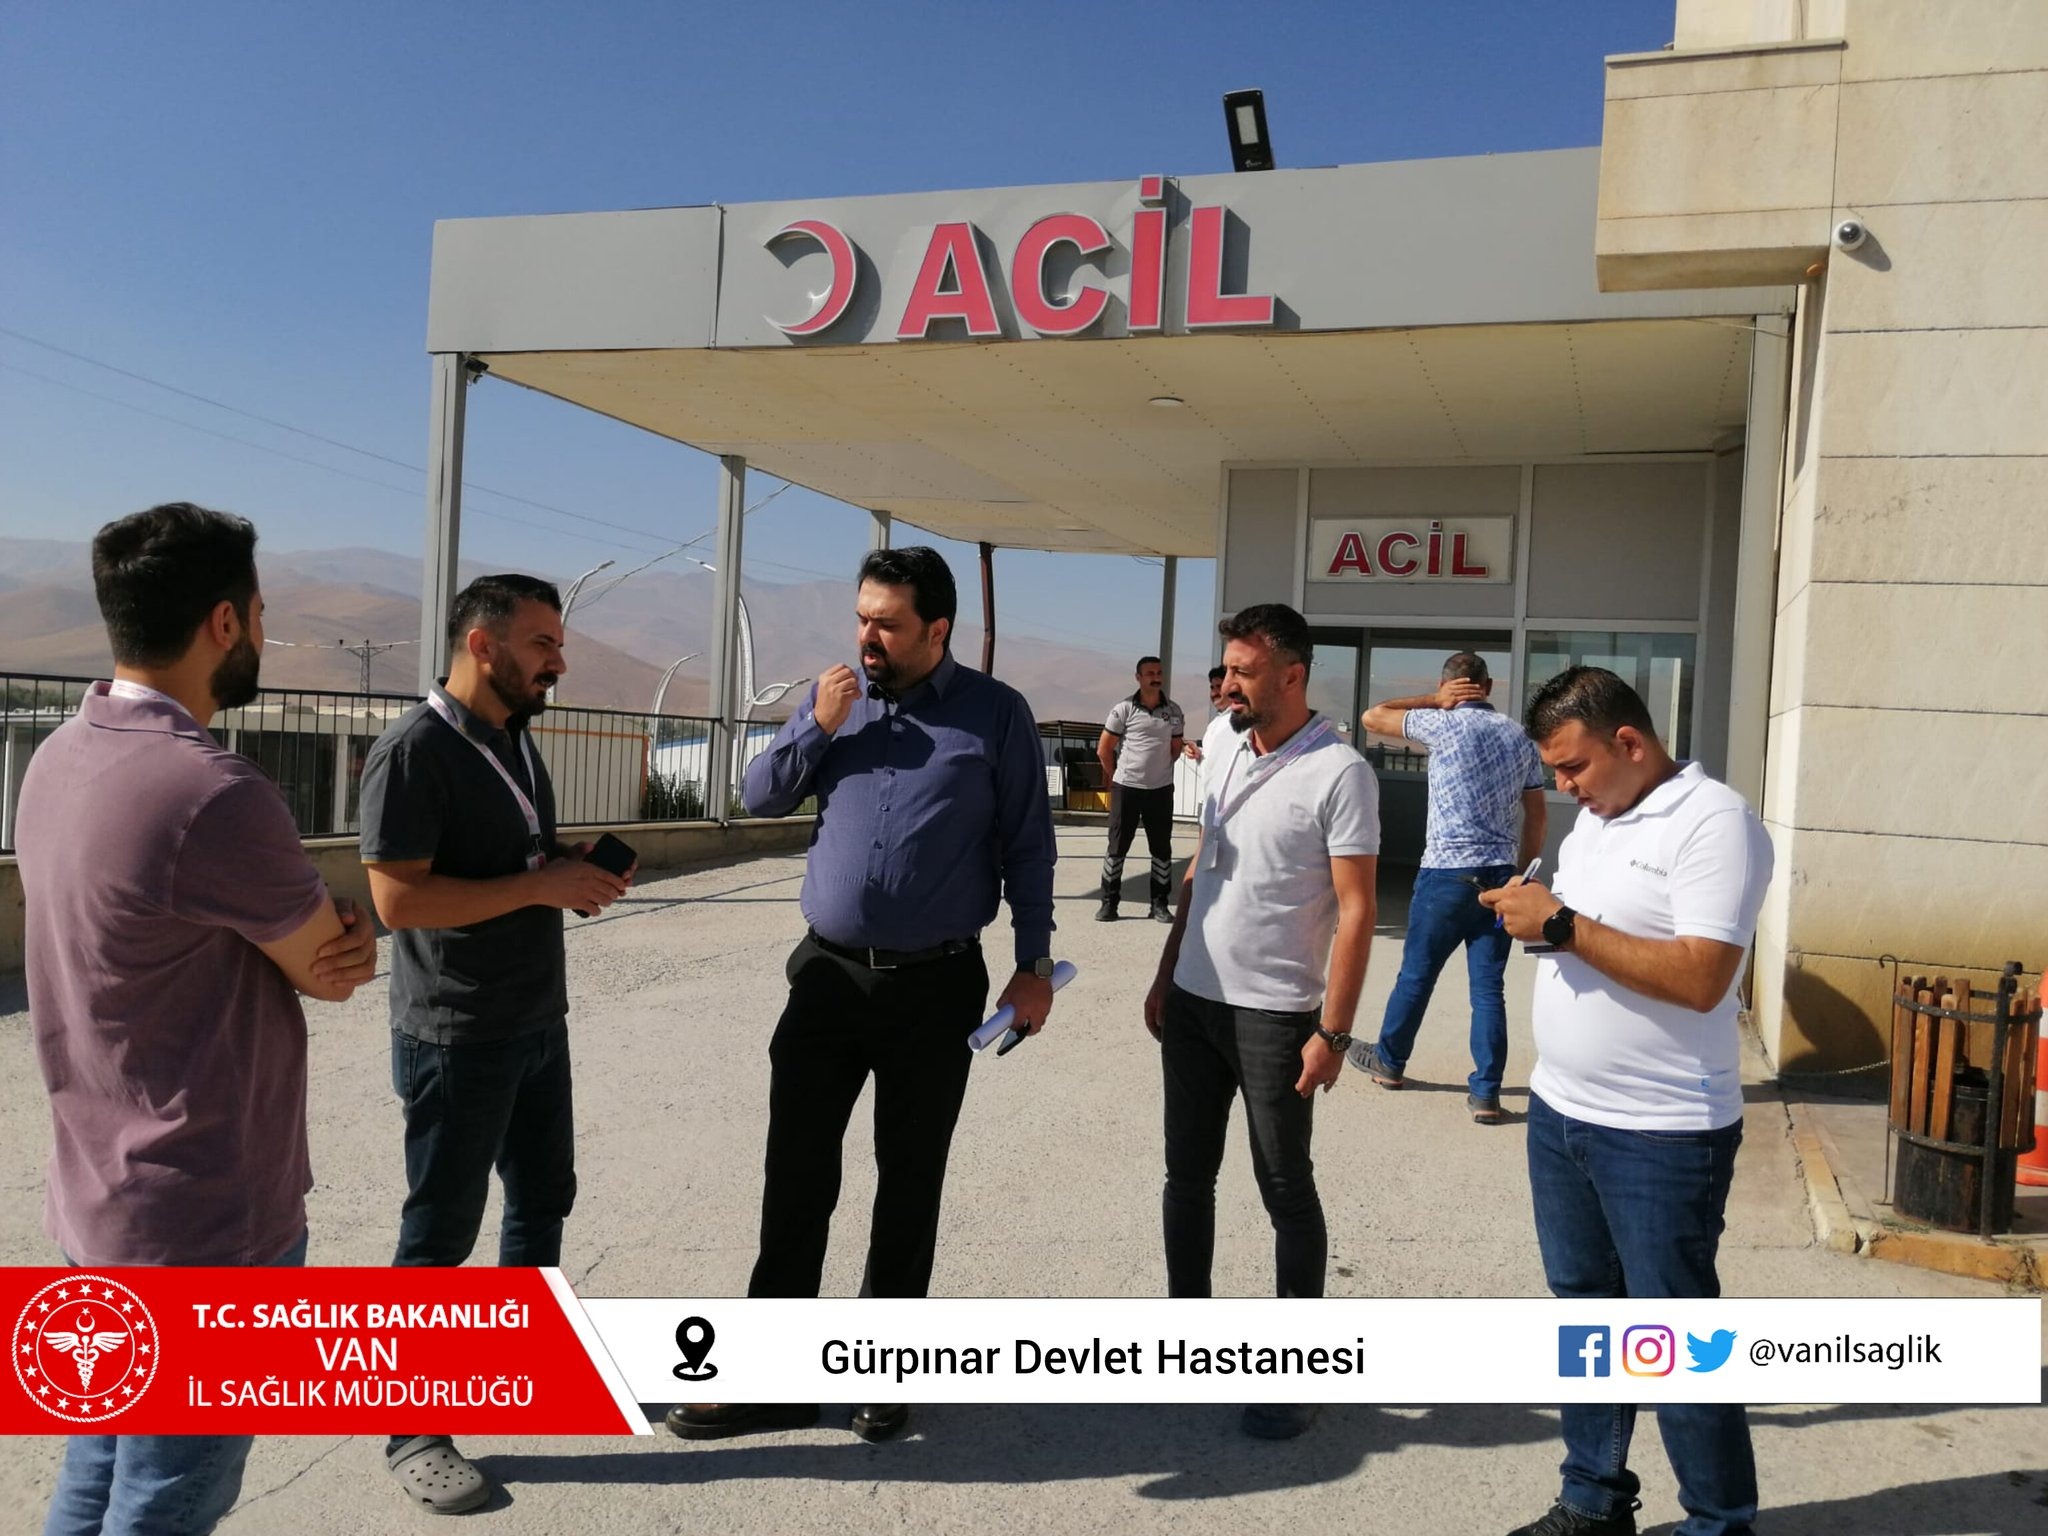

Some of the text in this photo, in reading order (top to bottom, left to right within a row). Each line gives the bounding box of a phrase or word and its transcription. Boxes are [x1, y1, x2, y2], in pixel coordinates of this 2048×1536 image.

[897, 174, 1276, 338] ACİL
[1327, 520, 1489, 577] ACİL
[1635, 861, 1668, 877] Columbia
